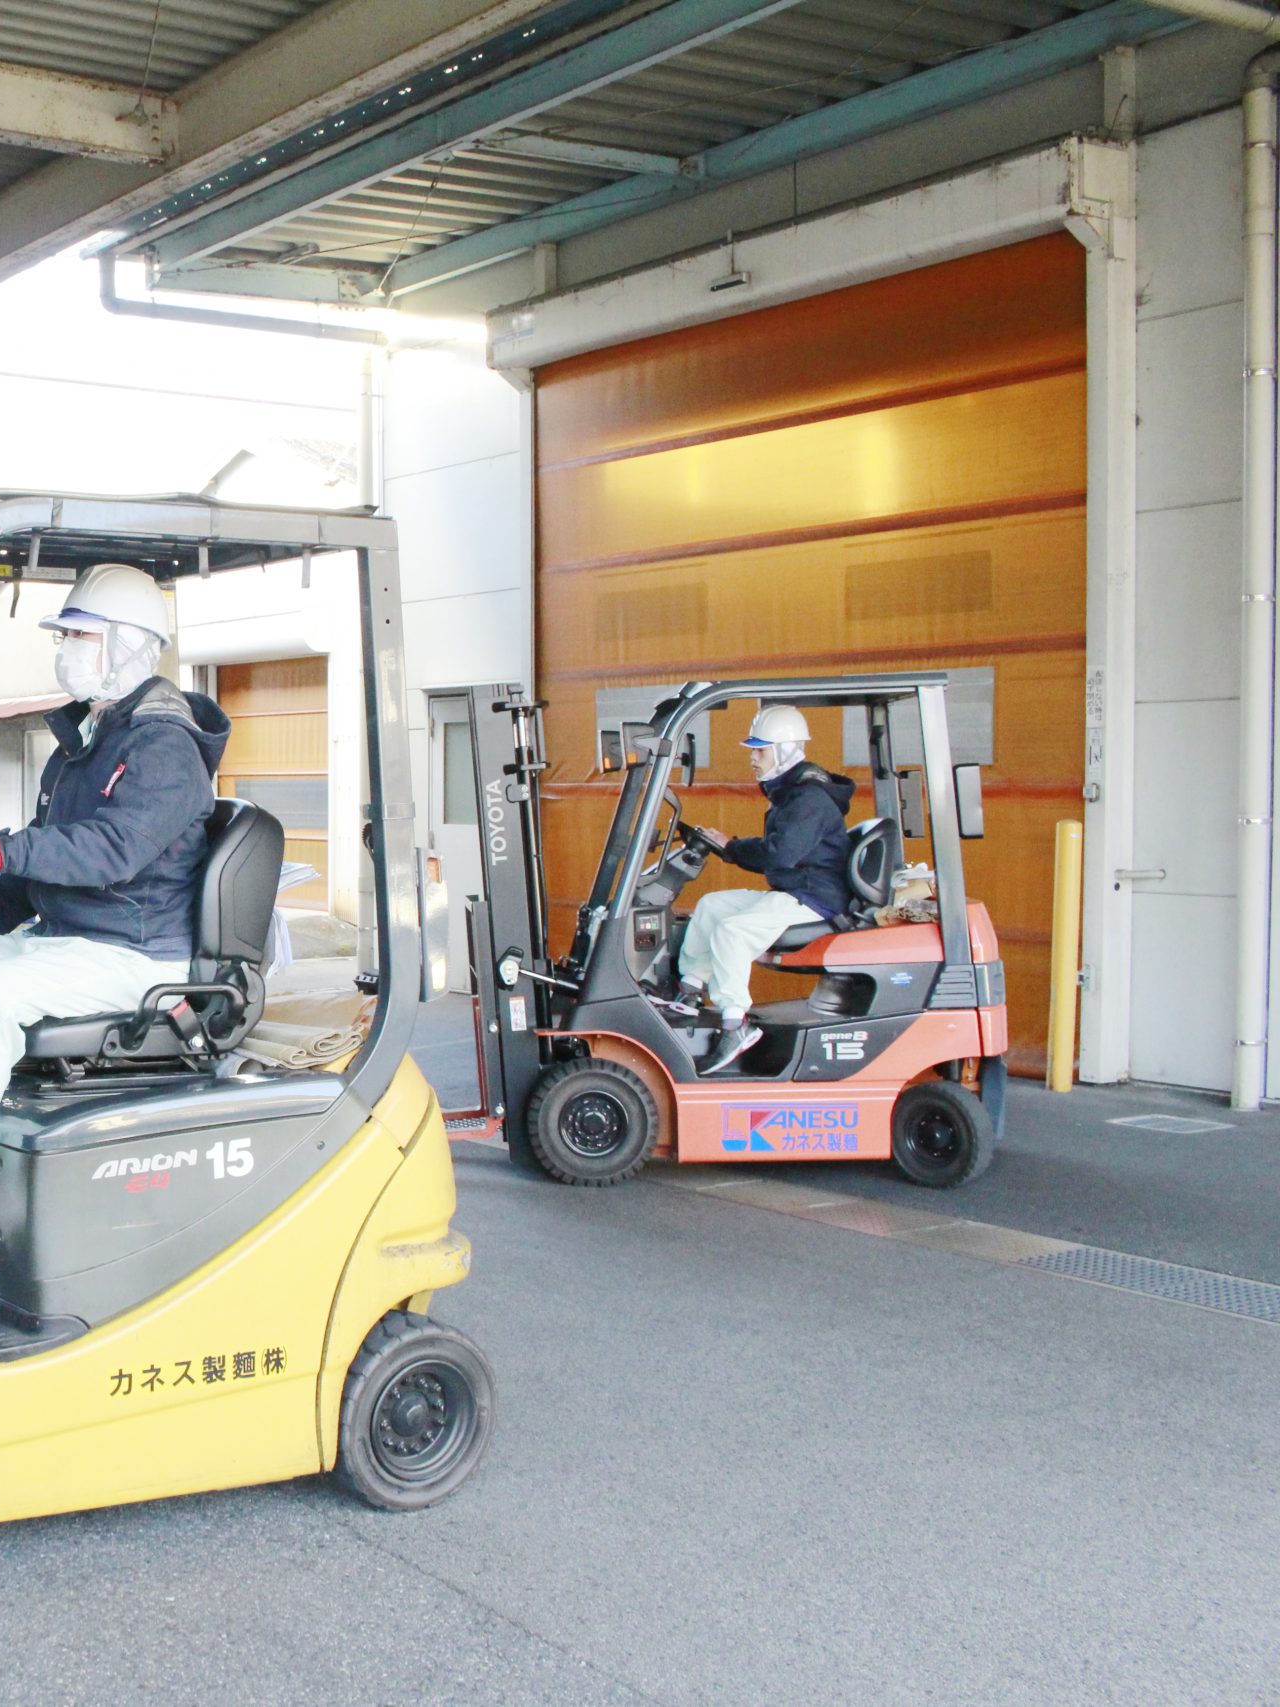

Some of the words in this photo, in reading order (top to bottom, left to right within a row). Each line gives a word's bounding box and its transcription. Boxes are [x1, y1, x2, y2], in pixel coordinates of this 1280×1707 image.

[486, 779, 508, 866] TOYOTA
[822, 1042, 865, 1060] 15
[91, 1149, 198, 1180] ARION
[206, 1137, 254, 1179] 15
